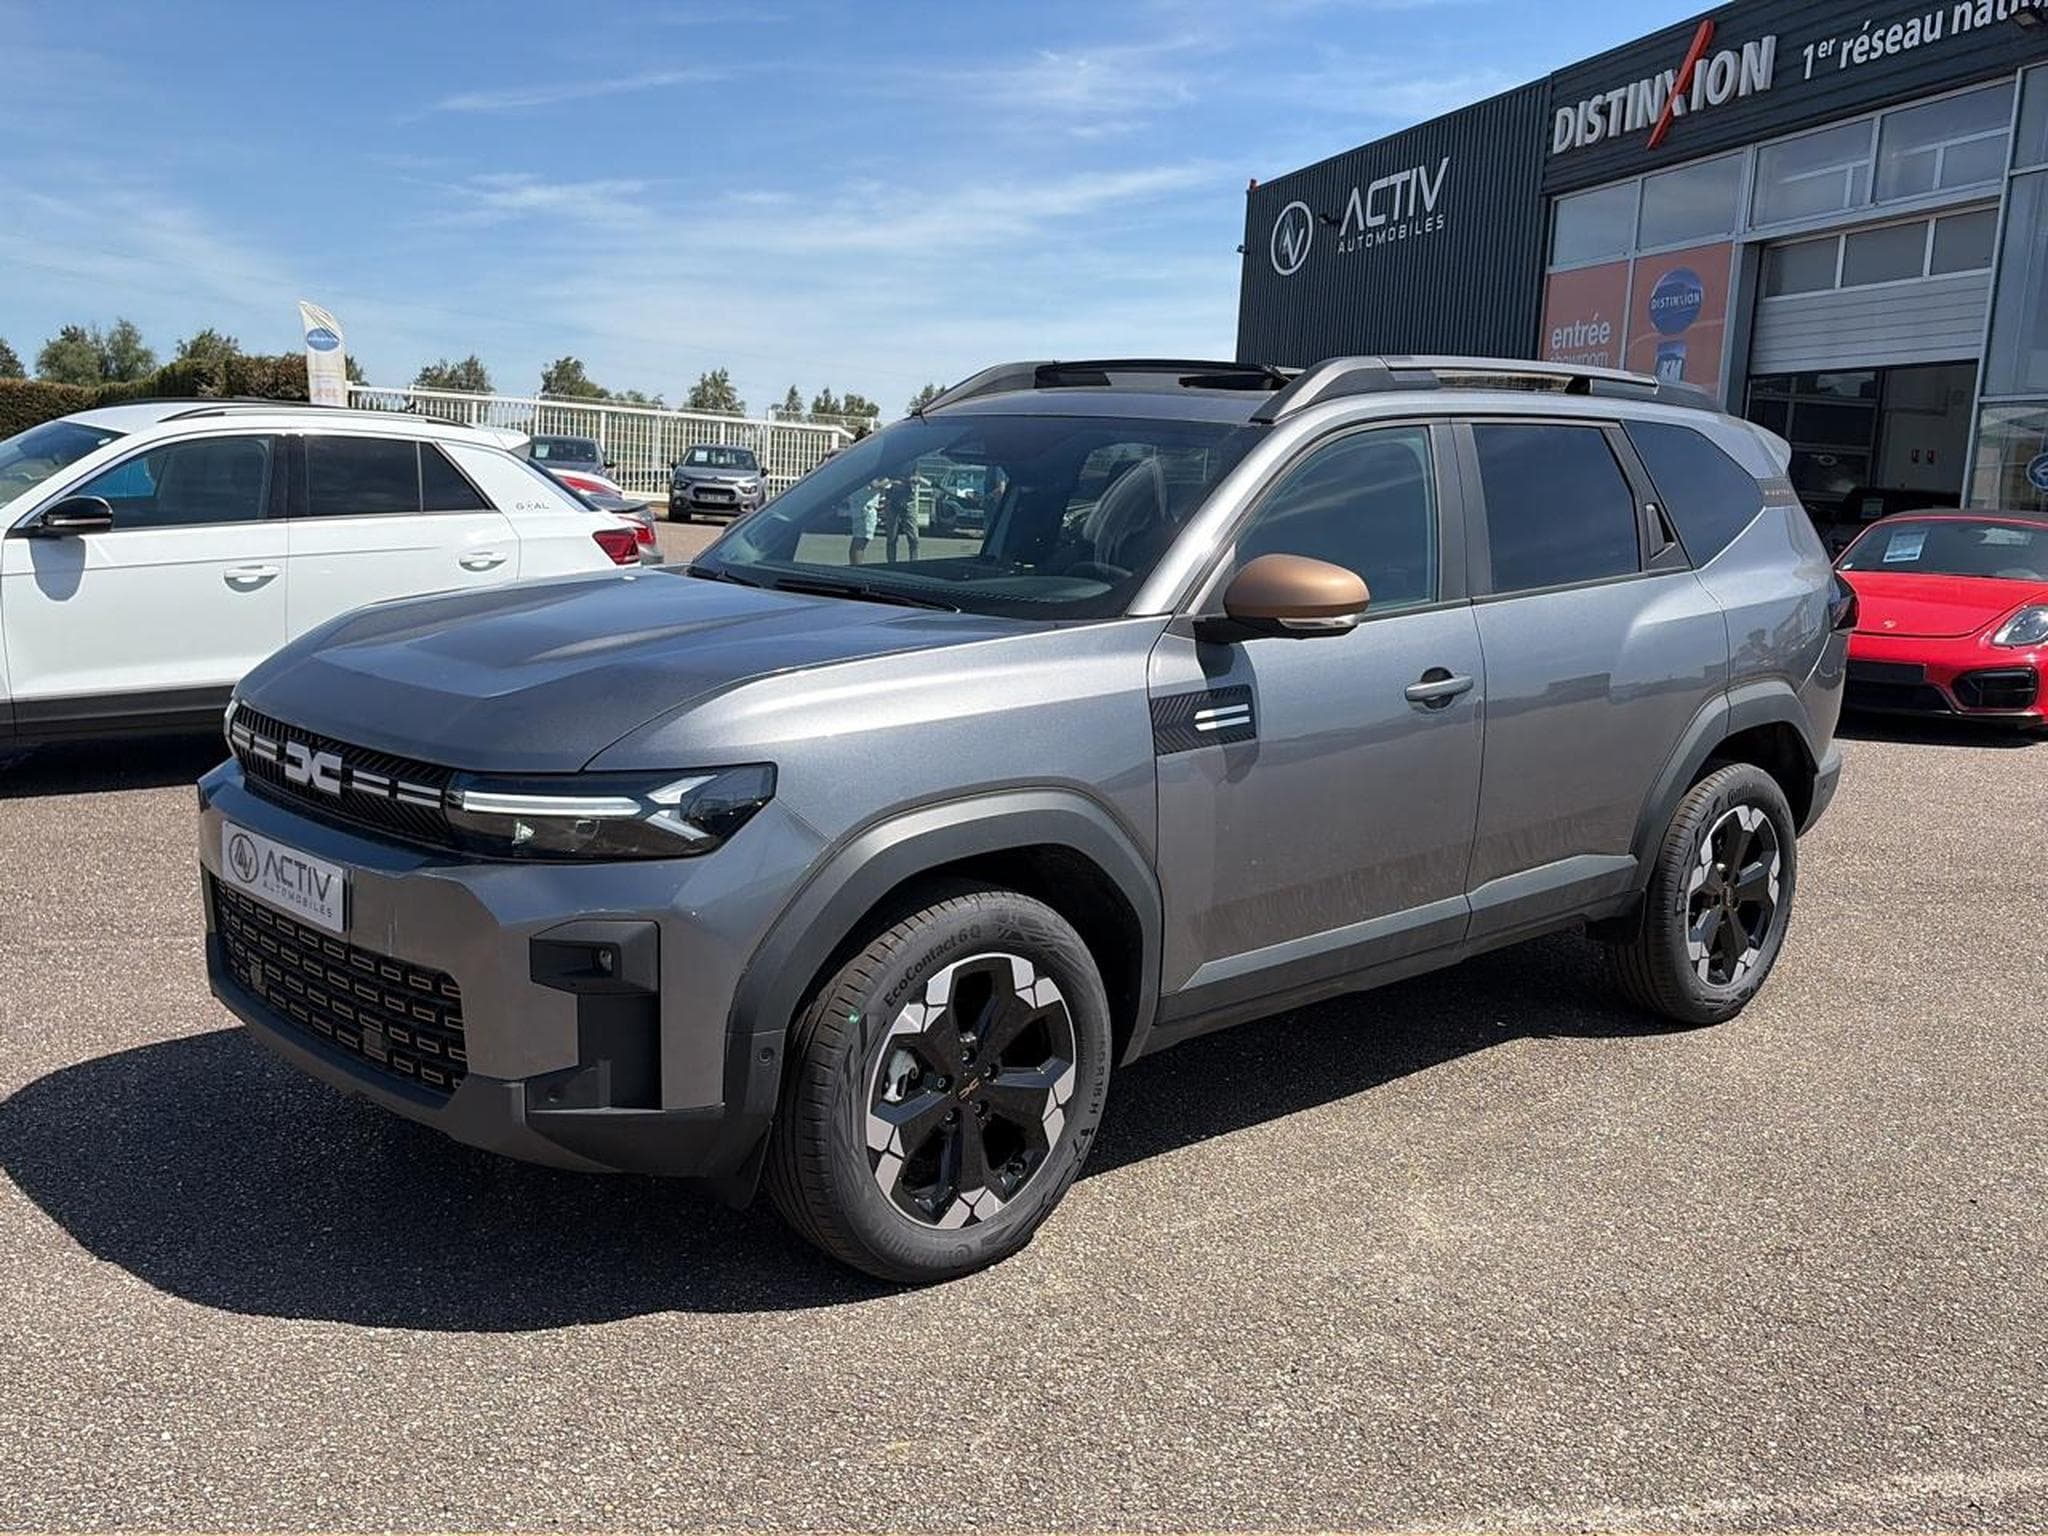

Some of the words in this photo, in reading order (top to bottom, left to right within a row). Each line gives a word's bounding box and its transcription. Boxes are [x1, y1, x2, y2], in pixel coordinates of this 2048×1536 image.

[1839, 10, 1944, 70] réseau
[1339, 156, 1450, 237] ACTIV
[1337, 213, 1445, 256] AUTOMOBILES
[1551, 312, 1612, 350] entrée
[262, 880, 333, 919] AUTOMOBILES
[263, 849, 332, 902] ACTIV
[883, 934, 957, 1007] EcoContact
